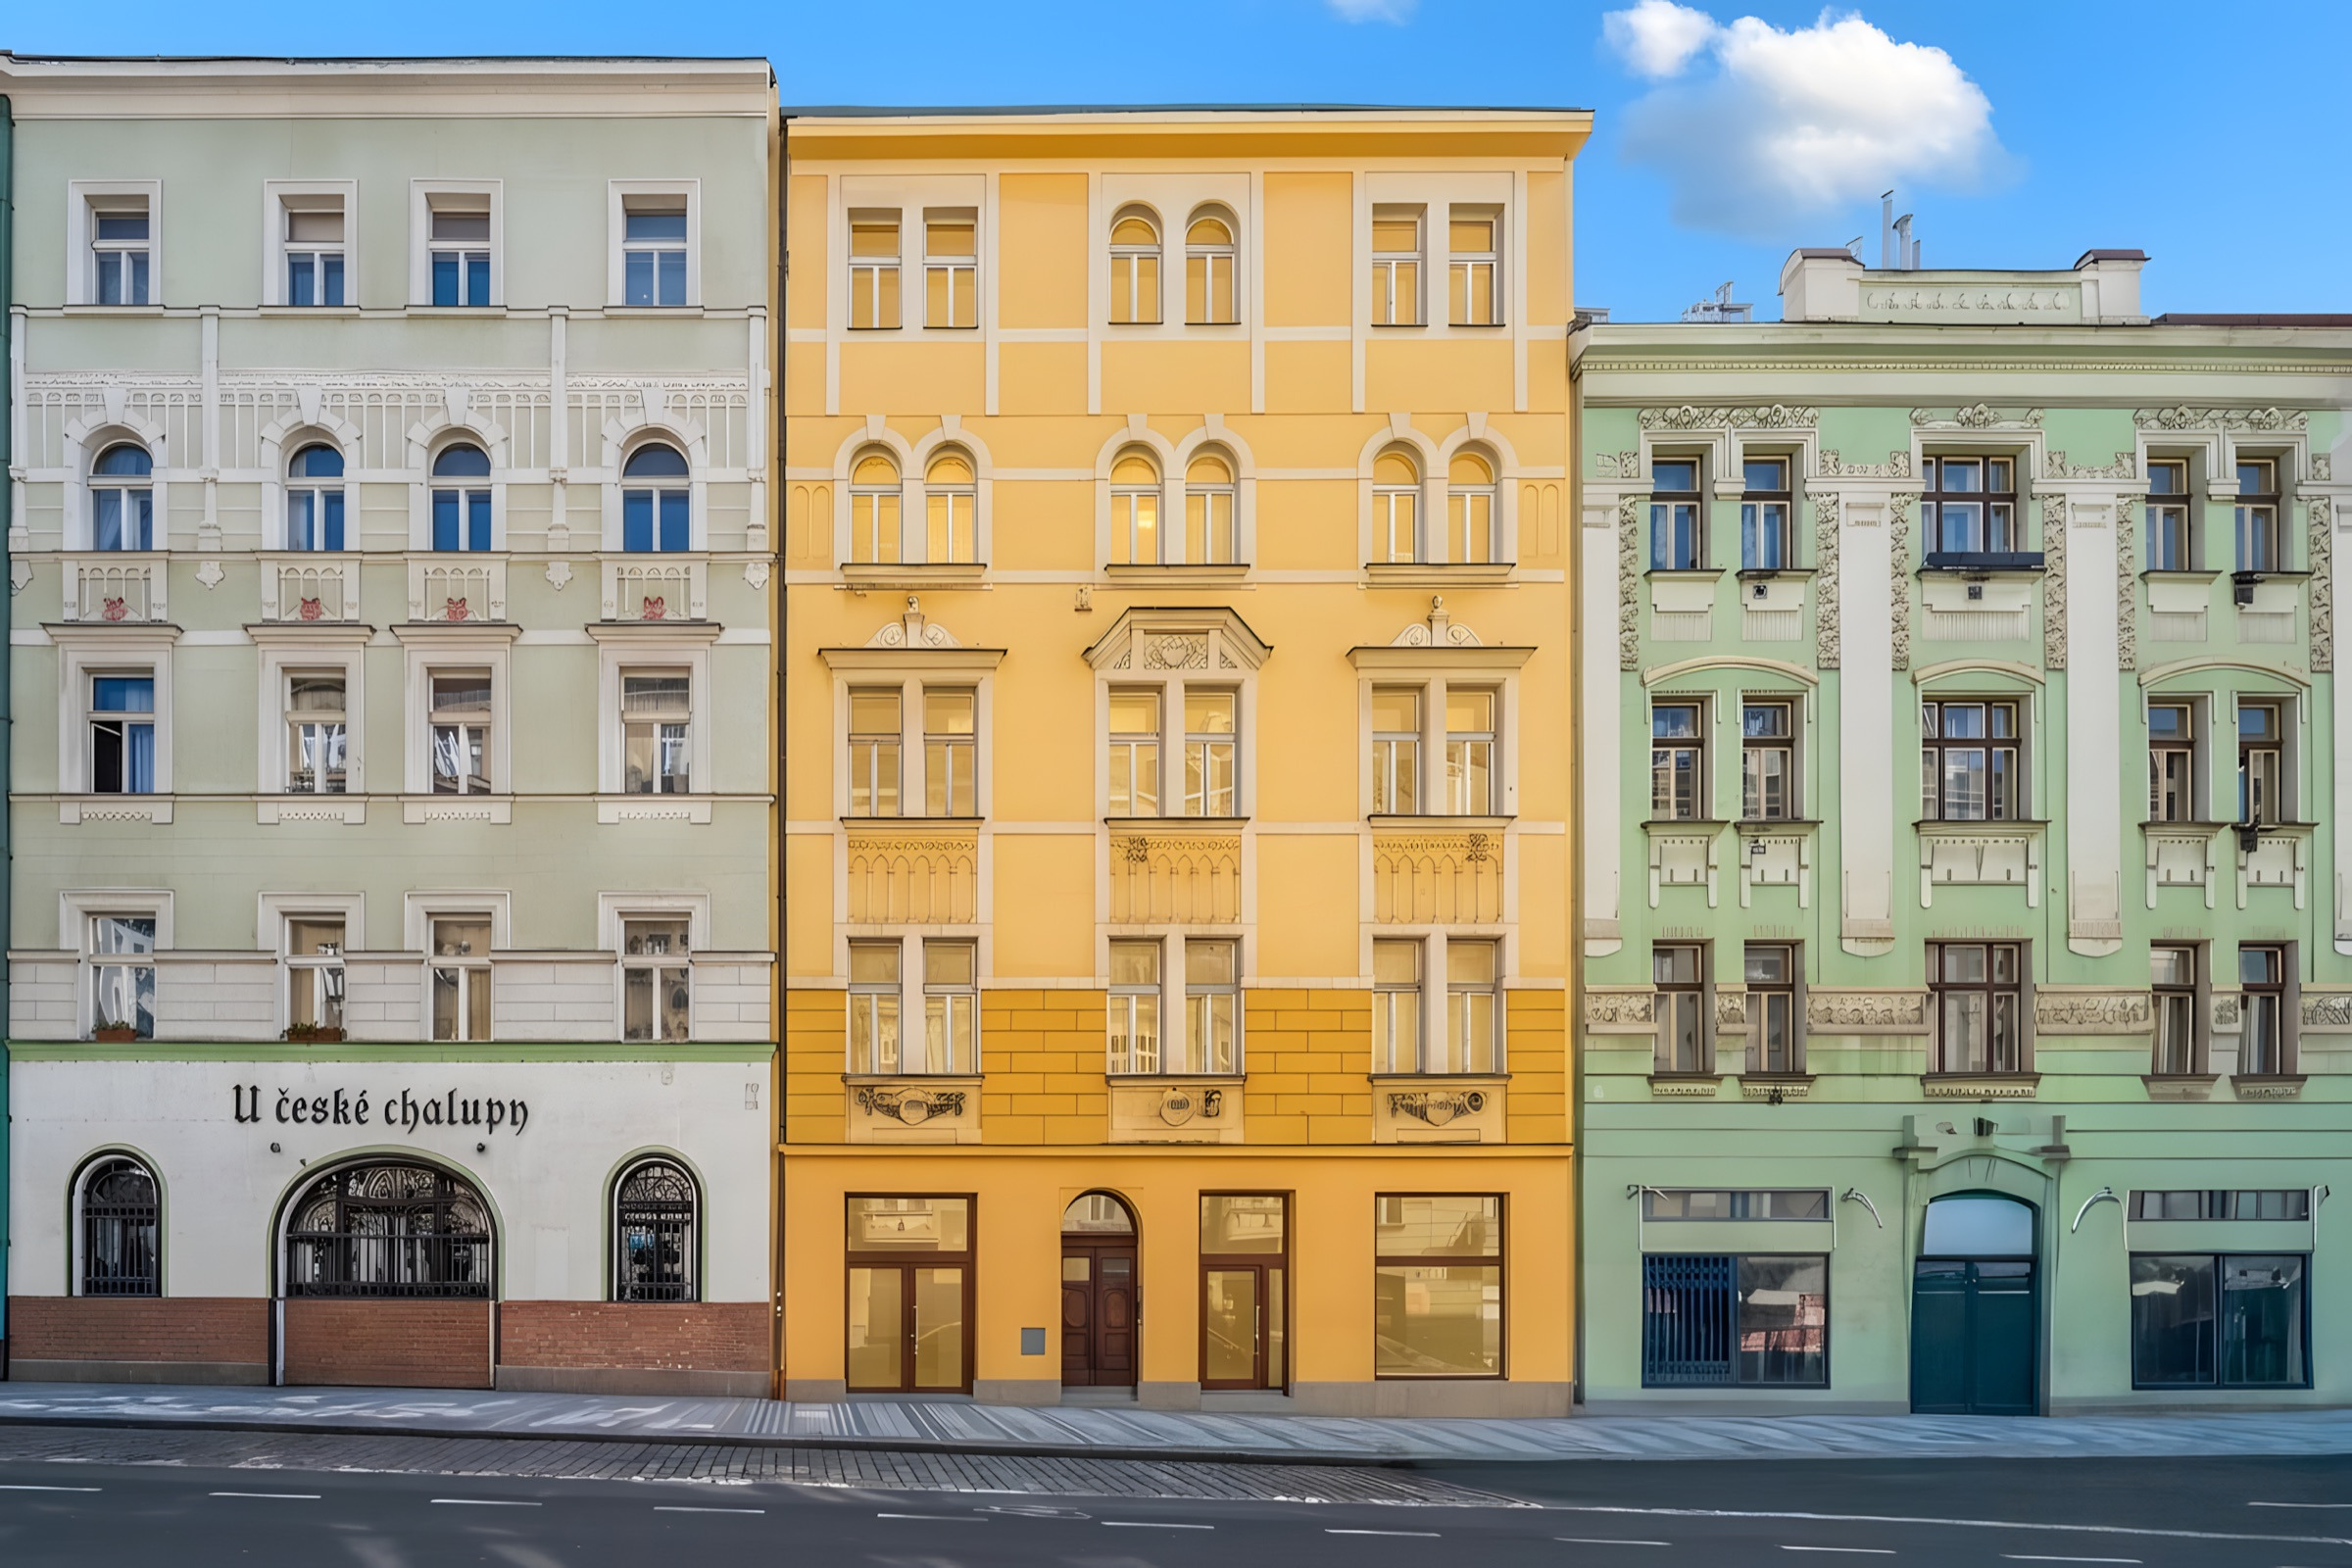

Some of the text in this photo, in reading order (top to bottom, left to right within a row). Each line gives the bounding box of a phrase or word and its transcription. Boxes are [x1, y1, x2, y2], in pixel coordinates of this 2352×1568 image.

[232, 1084, 530, 1137] U české chalupy
